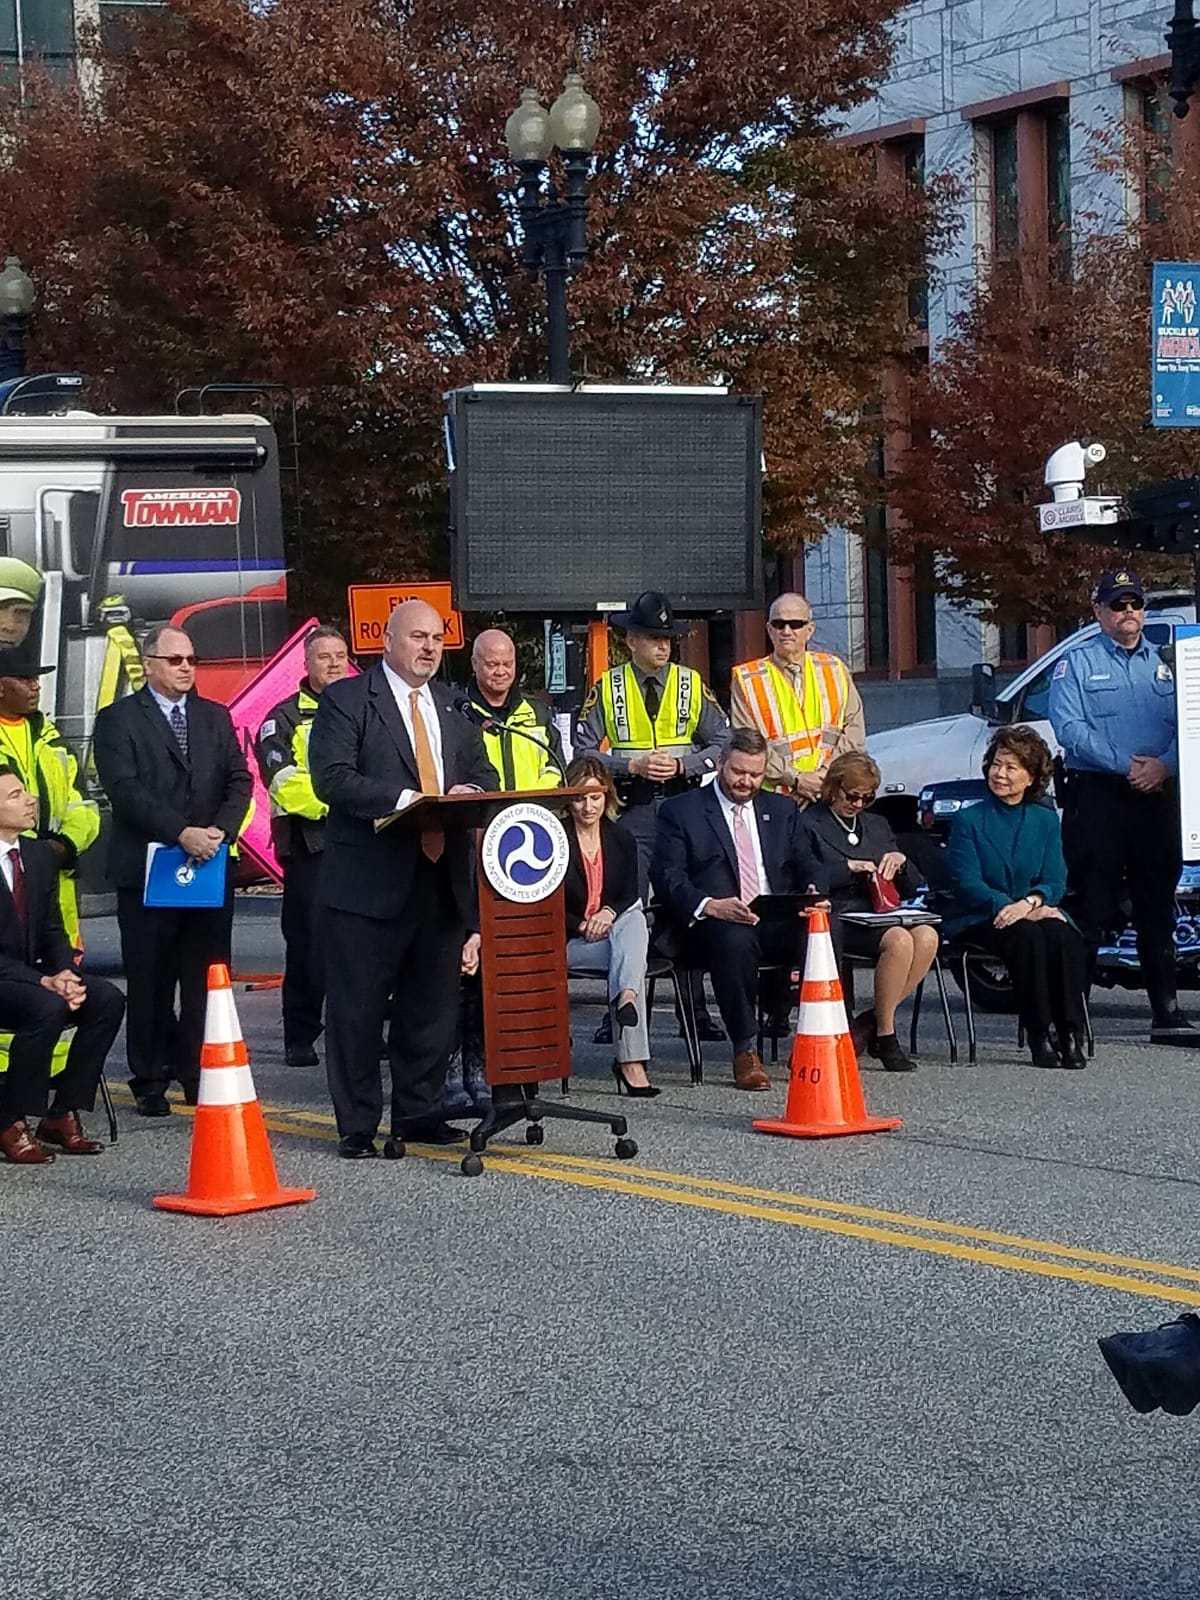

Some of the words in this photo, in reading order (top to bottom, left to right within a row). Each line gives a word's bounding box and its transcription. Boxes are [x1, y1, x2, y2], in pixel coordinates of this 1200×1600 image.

[1188, 327, 1199, 336] UP
[121, 488, 241, 527] TOWMAN
[141, 492, 230, 500] AMERICAN
[613, 674, 626, 727] STATE
[679, 676, 690, 724] POLICE
[486, 811, 514, 857] DEPARTMENT
[514, 807, 525, 816] OF
[526, 806, 566, 859] TRANSPORTATION
[487, 861, 505, 888] UNITED
[503, 885, 531, 899] STATES
[531, 888, 541, 898] OF
[542, 863, 564, 893] AMERICA
